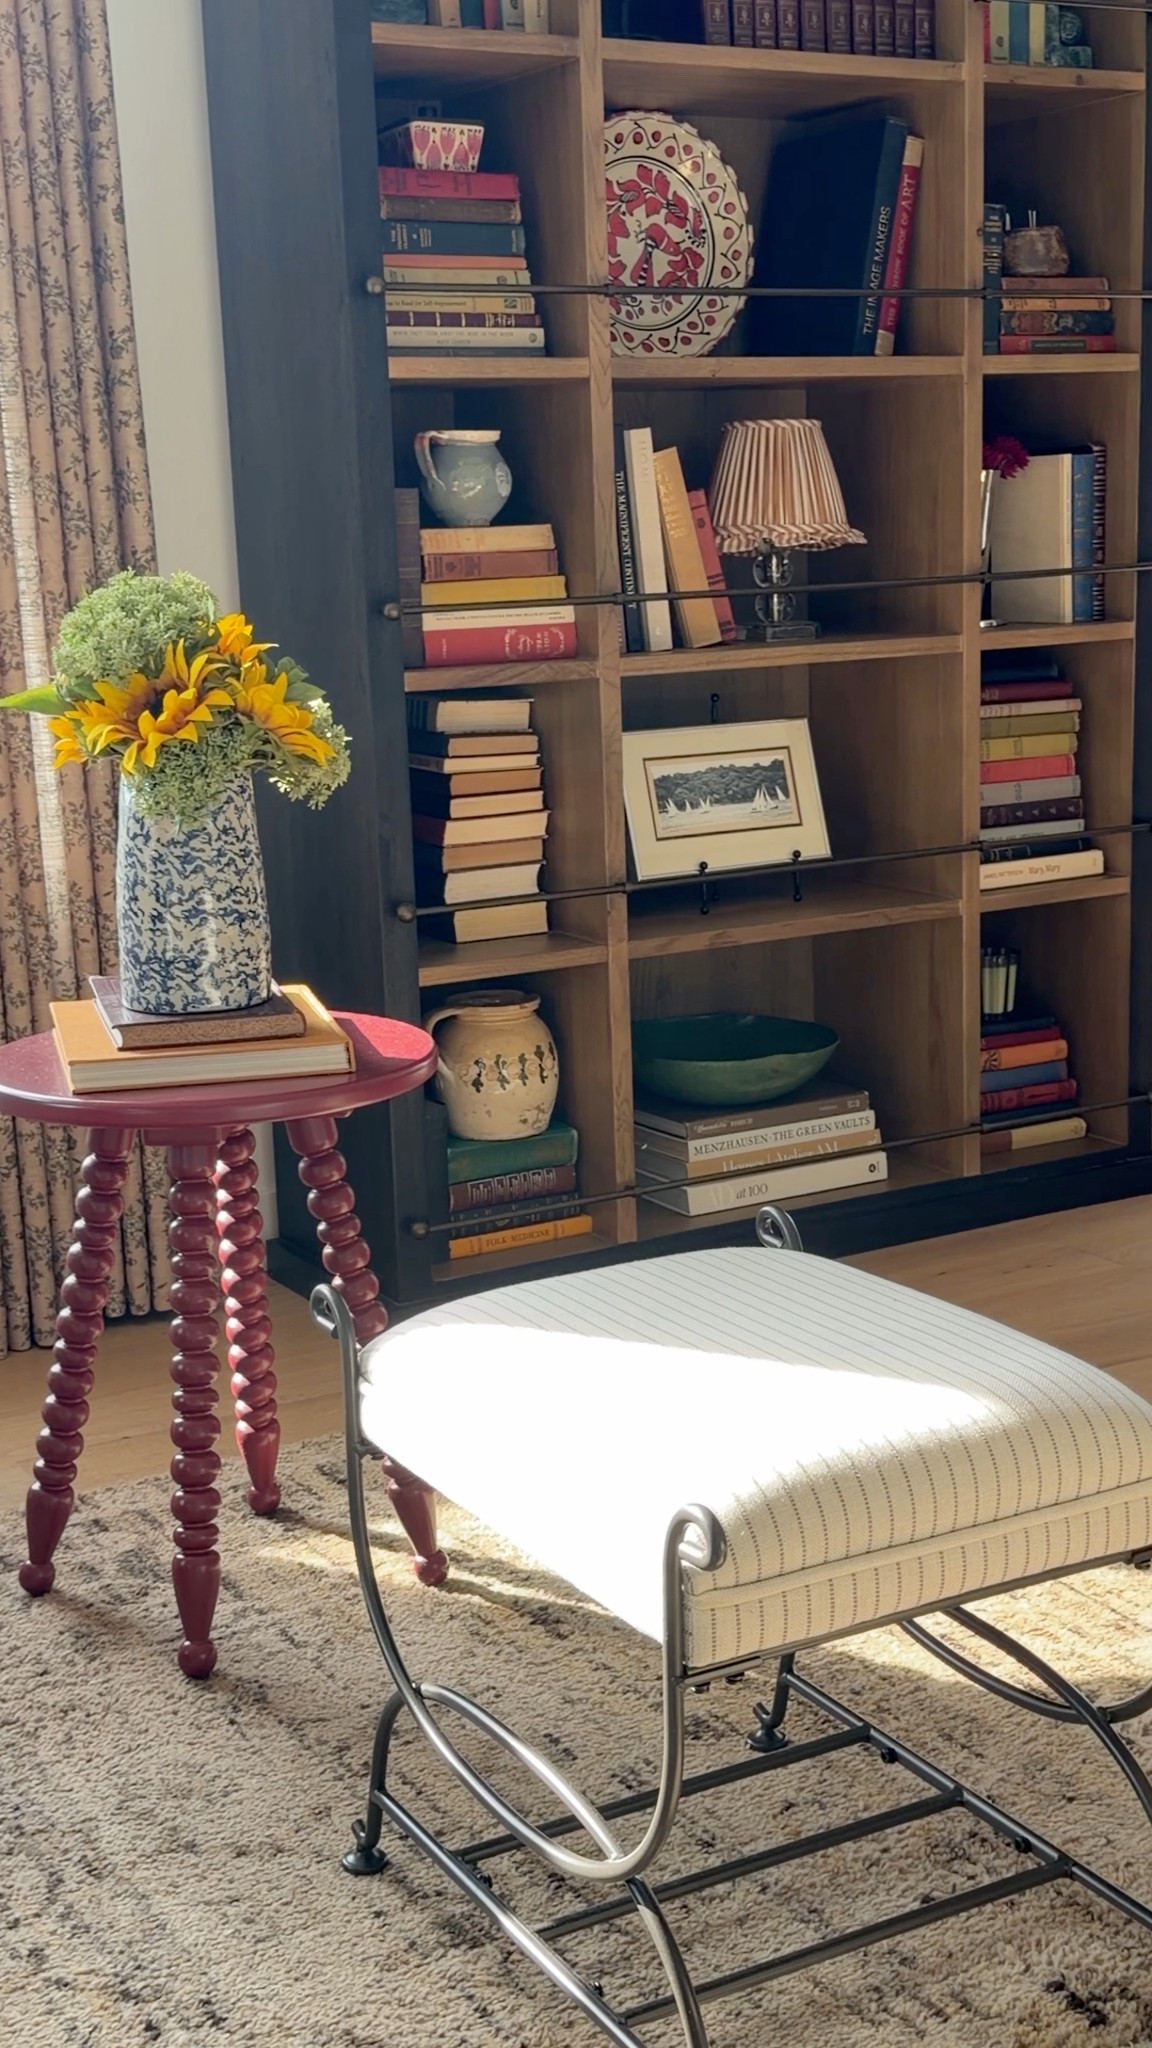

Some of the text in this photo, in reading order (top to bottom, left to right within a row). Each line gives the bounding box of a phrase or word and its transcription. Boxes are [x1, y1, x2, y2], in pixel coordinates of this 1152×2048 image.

[901, 173, 917, 210] ART
[863, 308, 876, 334] THE
[873, 205, 891, 262] MAKERS
[615, 471, 626, 493] THE
[617, 494, 632, 557] MAGNIFICENT
[772, 1129, 794, 1141] THE
[796, 1123, 832, 1138] GREEN
[835, 1115, 871, 1130] VAULTS
[736, 1188, 747, 1200] at
[749, 1184, 768, 1197] 100
[486, 1229, 550, 1247] FOLK MEDICINE
